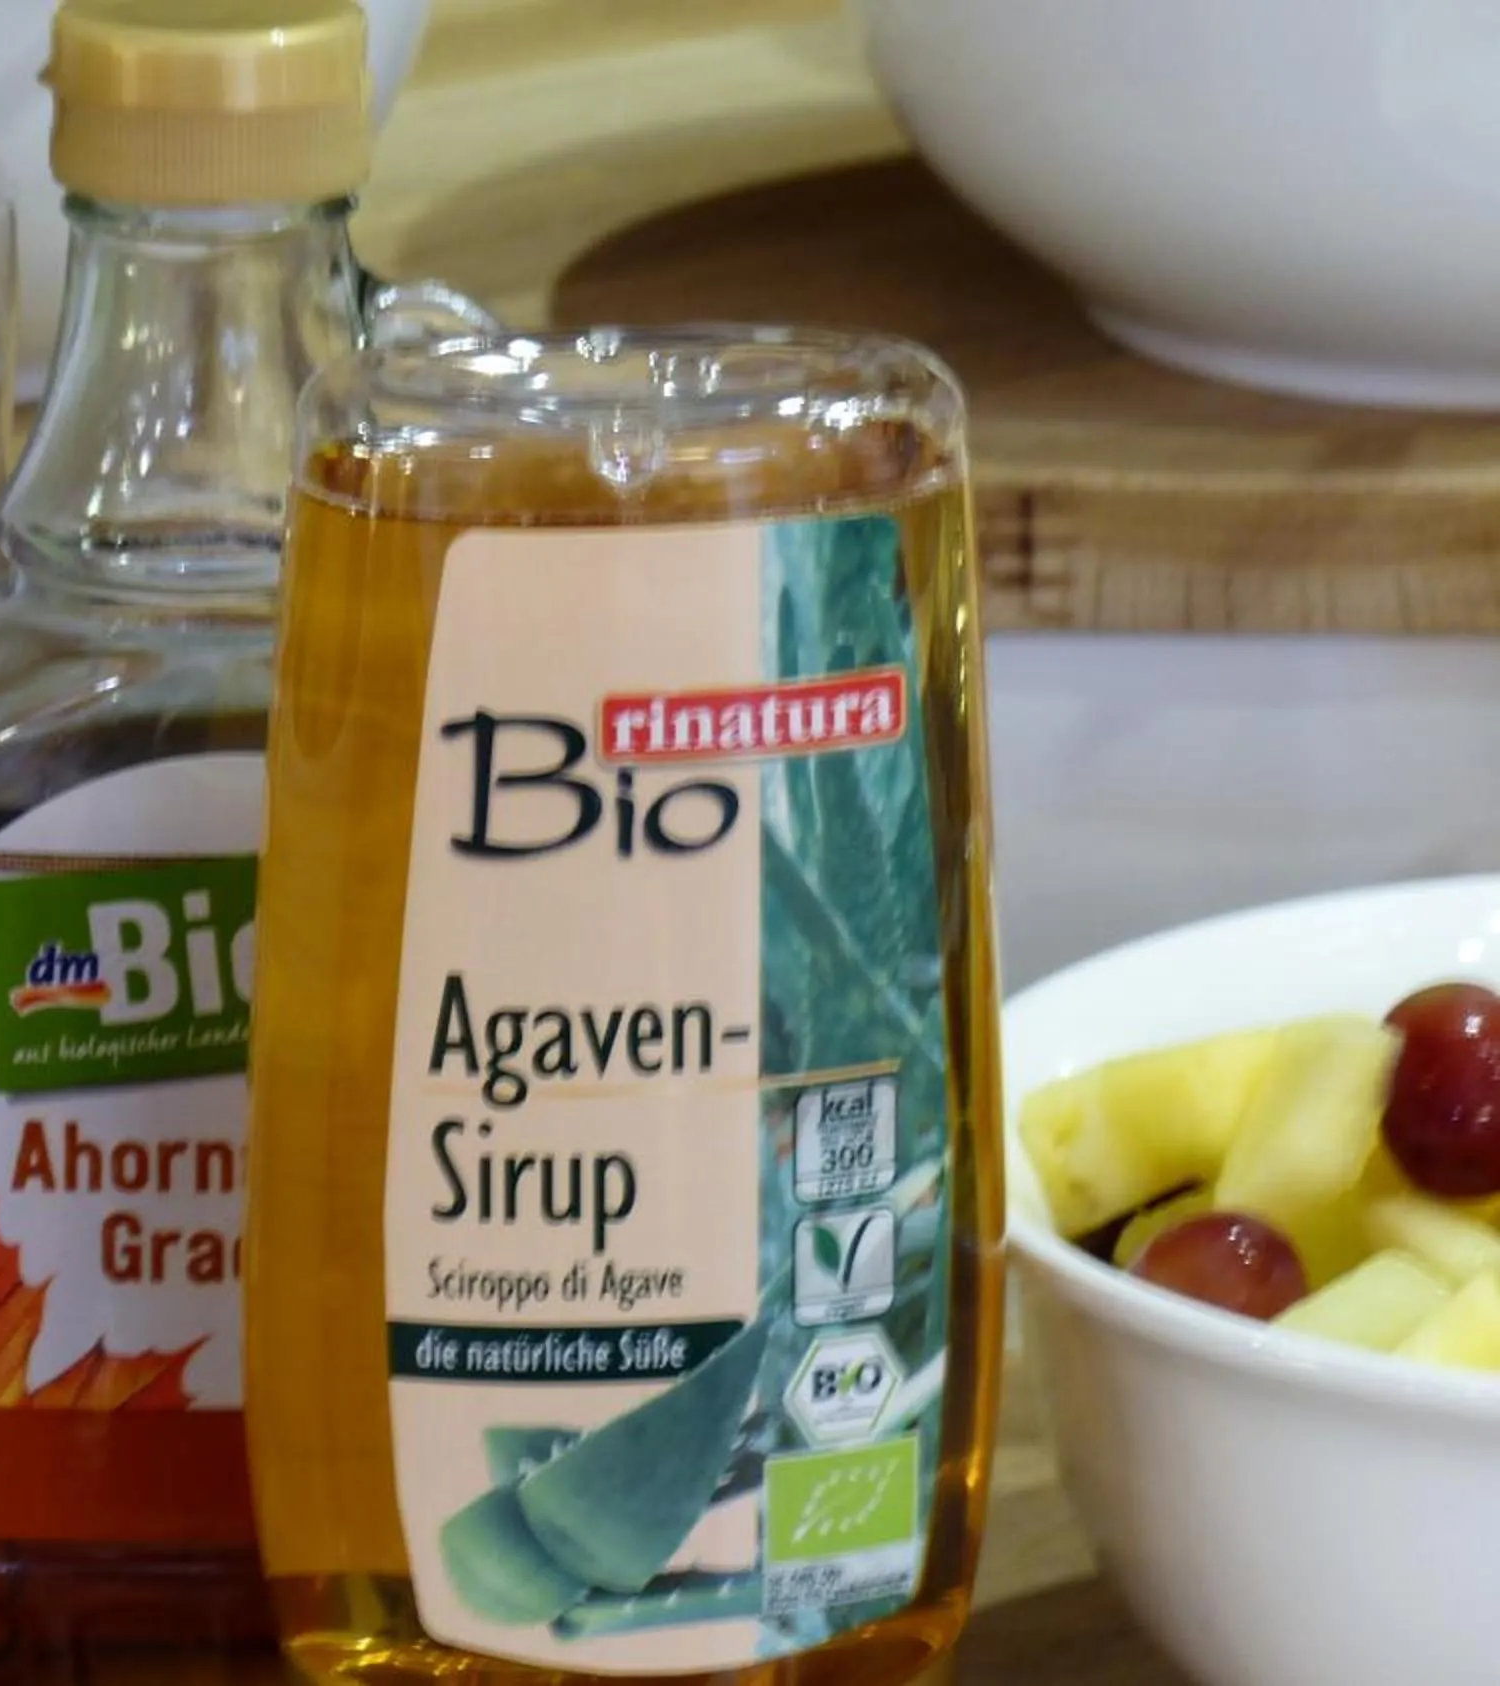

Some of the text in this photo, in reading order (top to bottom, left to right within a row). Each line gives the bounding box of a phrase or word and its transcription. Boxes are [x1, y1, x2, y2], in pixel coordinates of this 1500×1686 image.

[610, 684, 897, 753] rinatura
[439, 708, 740, 862] Bio
[27, 938, 100, 986] dm
[428, 971, 751, 1110] Agaven-
[821, 1080, 876, 1122] kcal
[12, 1119, 248, 1194] Ahorn
[430, 1116, 638, 1256] Sirup
[821, 1143, 874, 1174] 300
[102, 1212, 241, 1285] Gra
[427, 1256, 685, 1312] Sciroppo di Agave
[415, 1328, 688, 1373] die natürliche Süße
